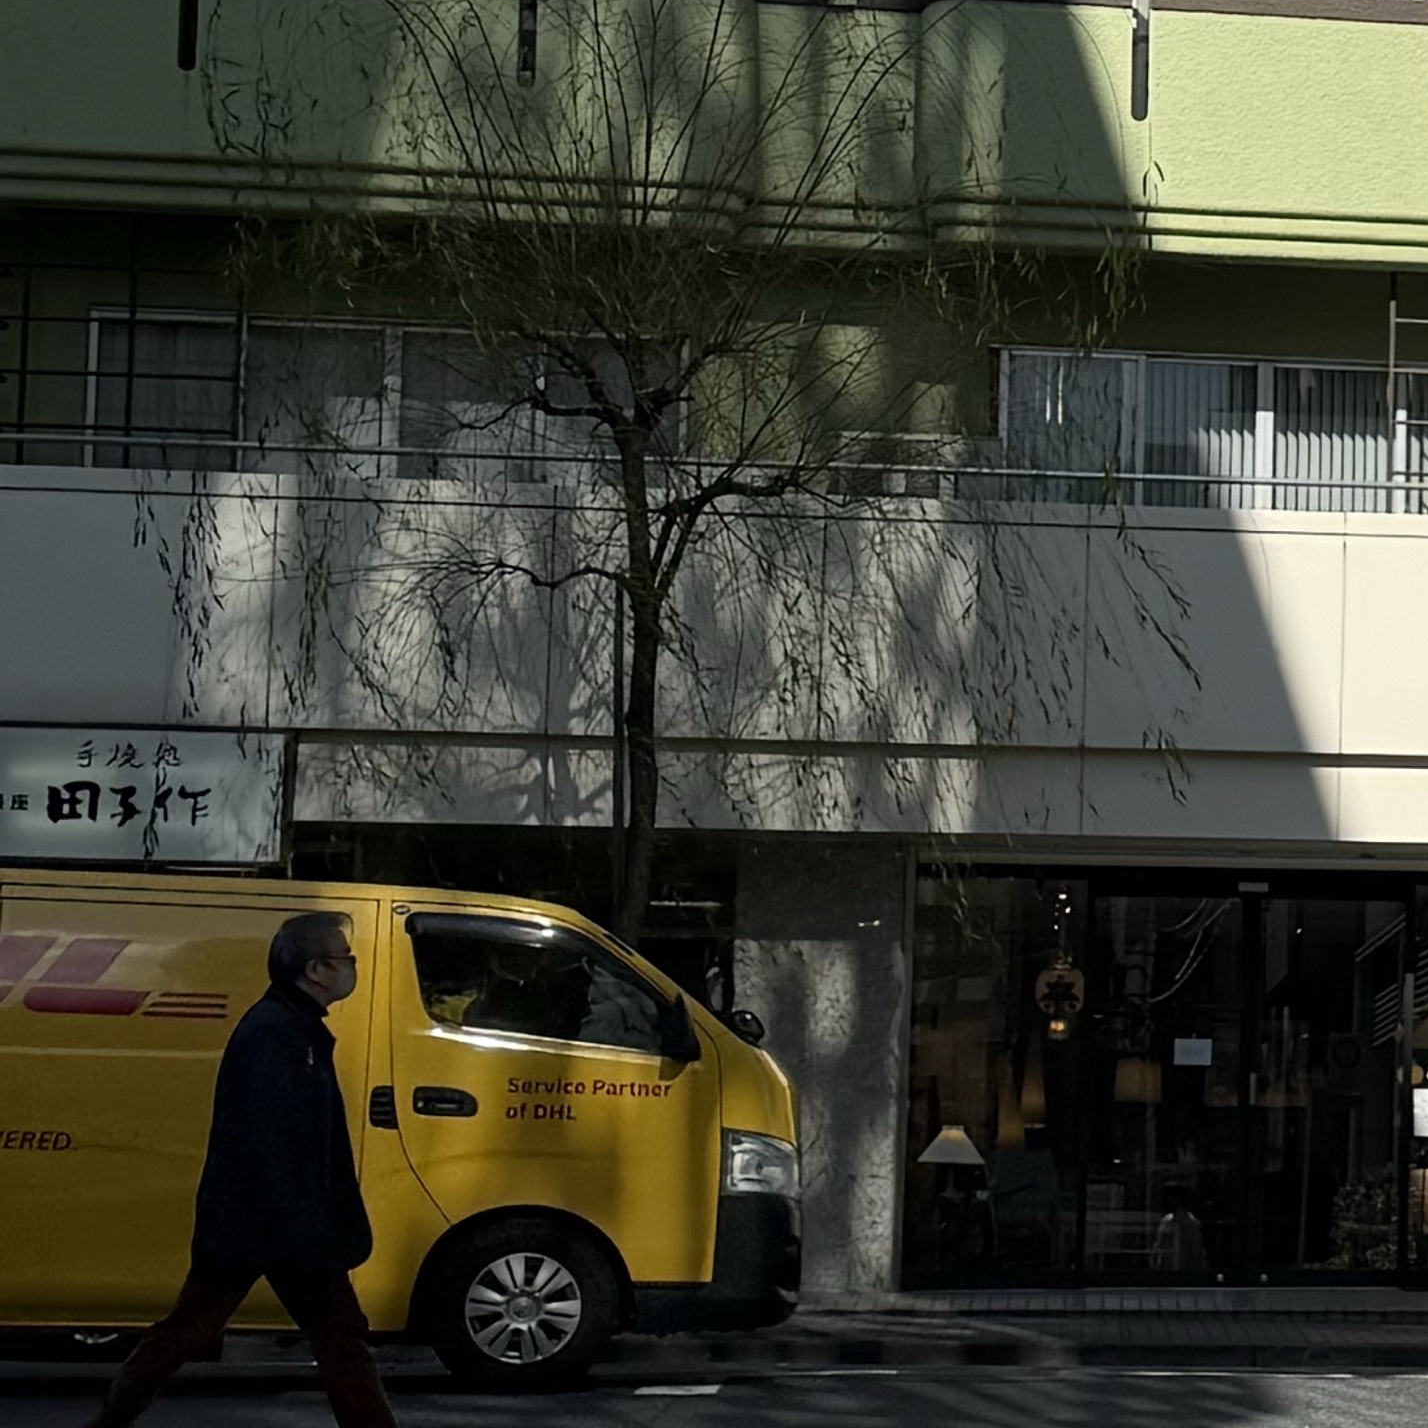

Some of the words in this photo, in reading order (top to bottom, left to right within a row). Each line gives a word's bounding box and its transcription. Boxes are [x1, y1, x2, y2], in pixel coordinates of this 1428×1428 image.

[507, 1077, 586, 1094] Service
[592, 1079, 673, 1097] Partner
[505, 1103, 527, 1120] of
[533, 1103, 577, 1121] DHL
